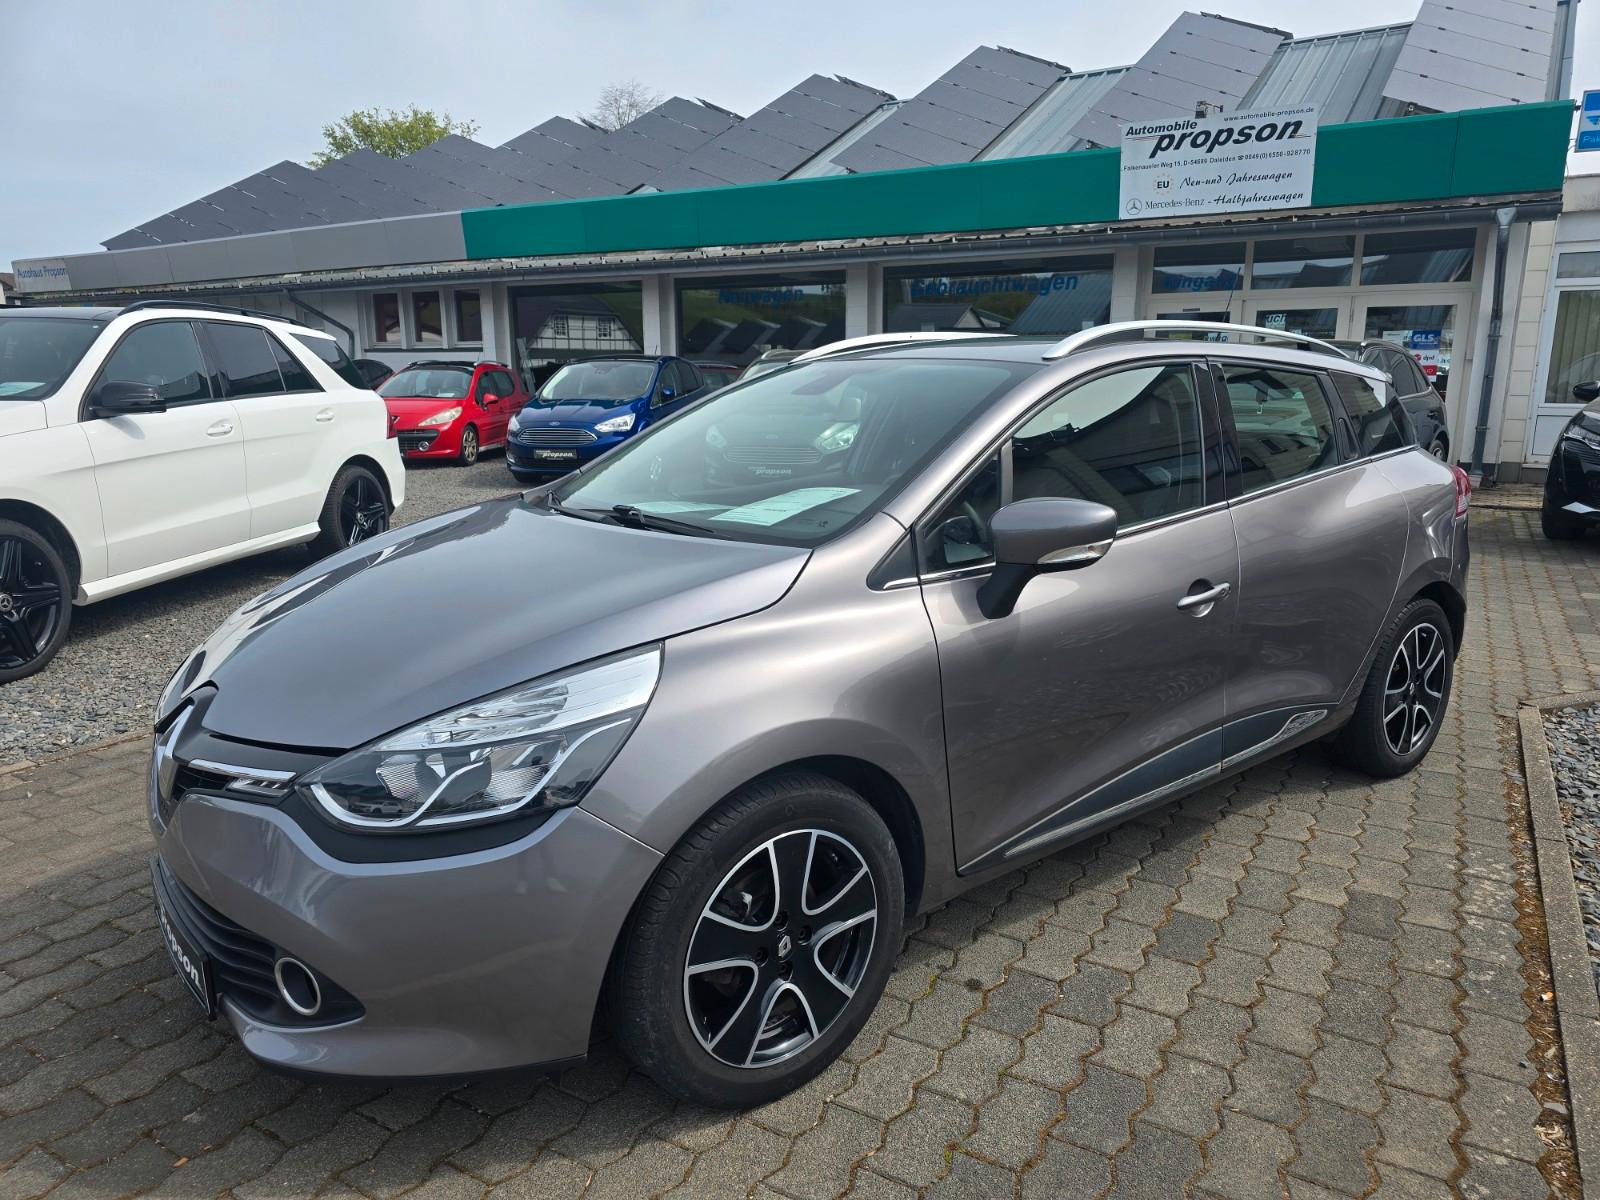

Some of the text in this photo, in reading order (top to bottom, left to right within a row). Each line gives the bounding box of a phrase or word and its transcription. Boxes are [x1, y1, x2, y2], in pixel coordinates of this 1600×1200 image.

[1125, 119, 1198, 137] Automobile
[1149, 119, 1303, 159] propson
[1156, 180, 1170, 189] EU
[1225, 171, 1293, 186] Jahreswagen
[1144, 198, 1205, 210] Mercedes-Benz
[911, 274, 1078, 297] Gebrauchtwagen
[1413, 334, 1435, 342] GLS
